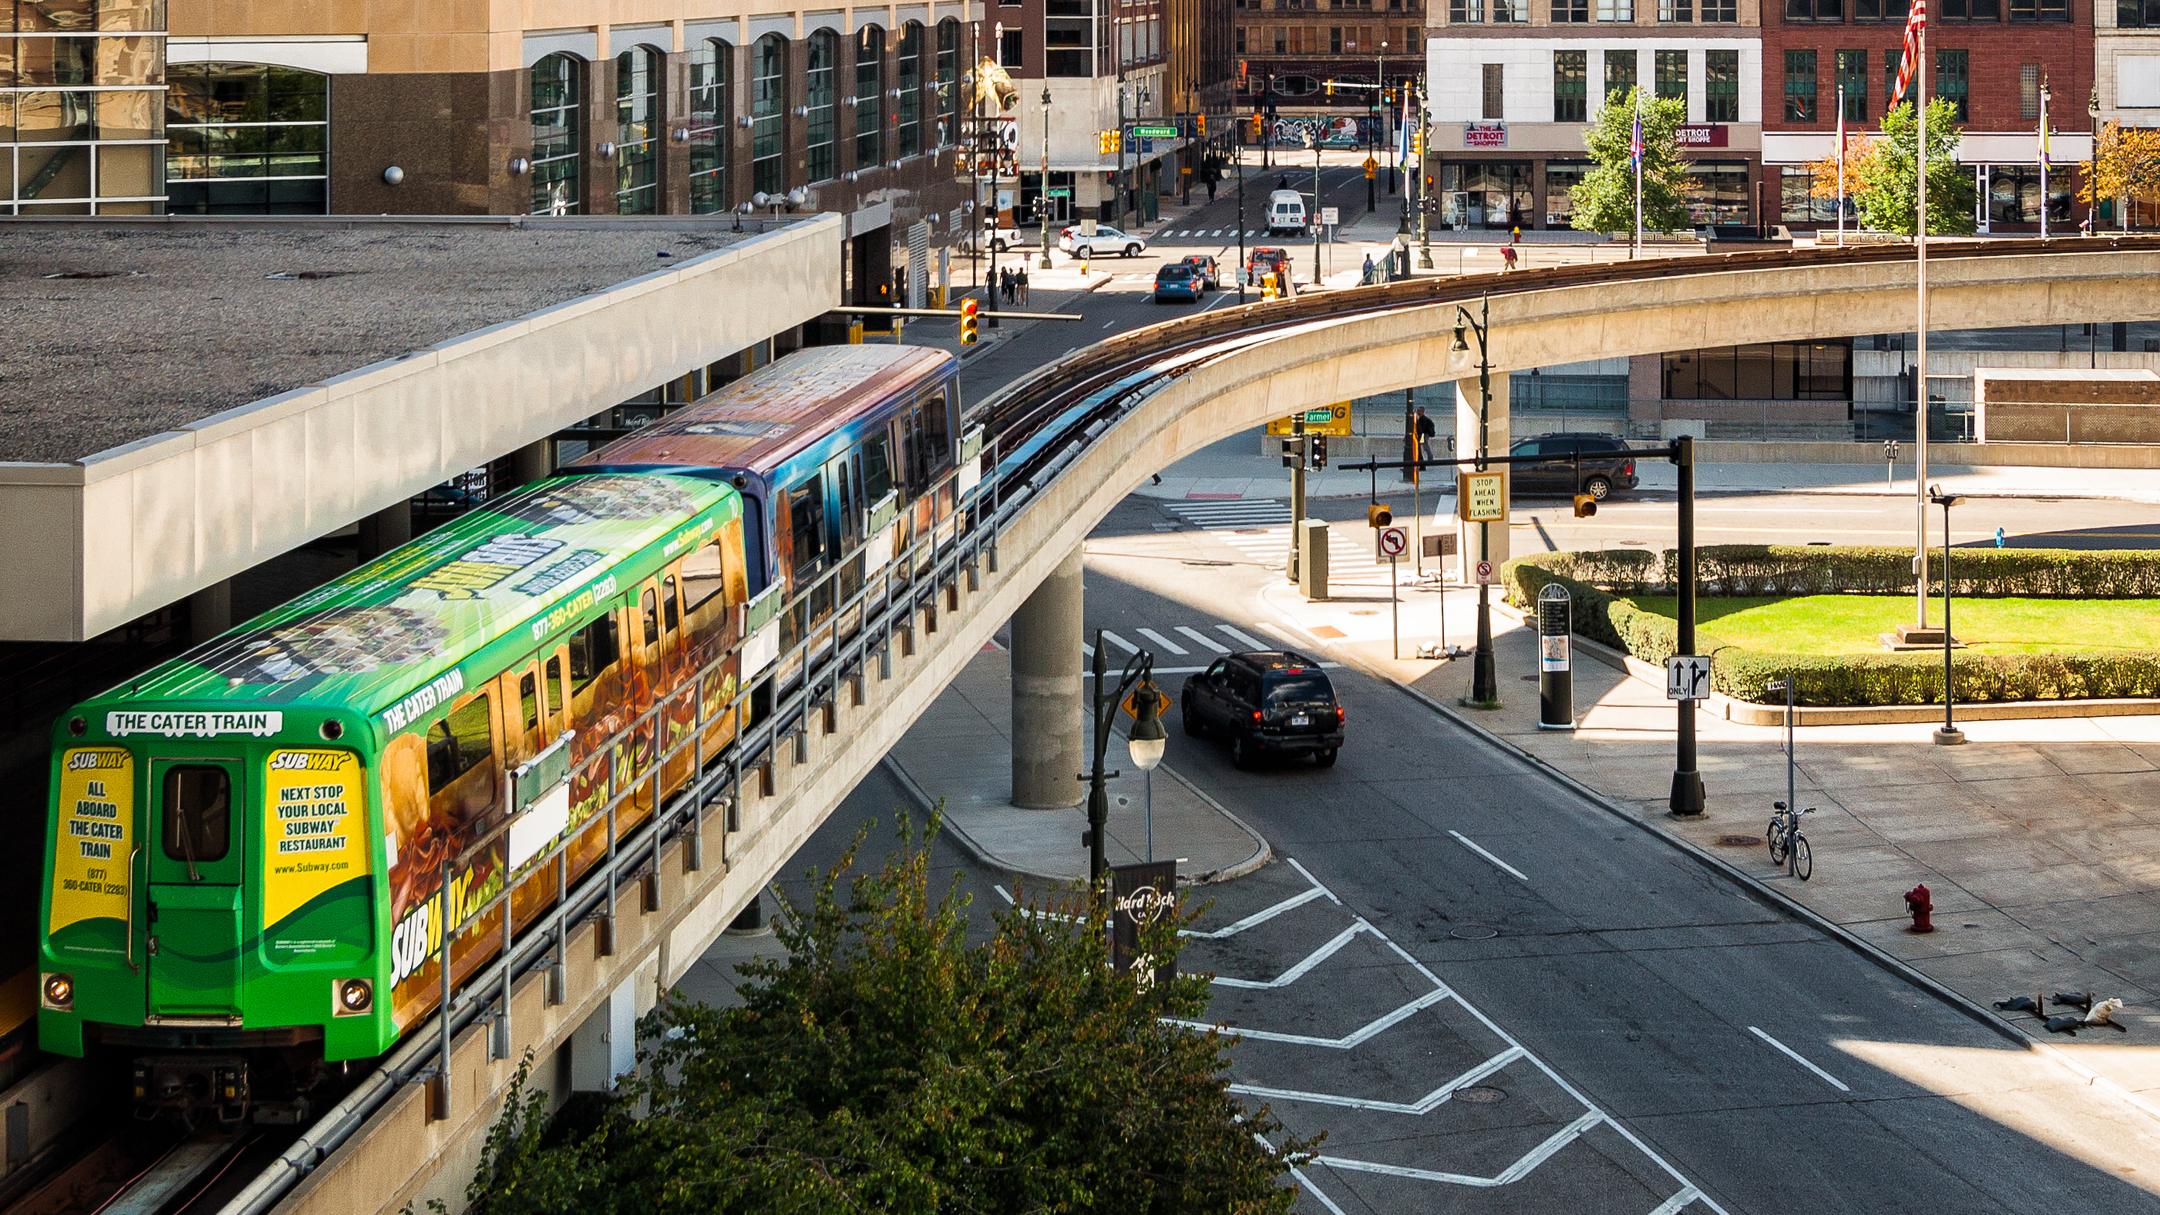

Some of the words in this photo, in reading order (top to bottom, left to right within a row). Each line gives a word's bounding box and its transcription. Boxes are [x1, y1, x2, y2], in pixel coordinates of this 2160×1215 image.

[1466, 132, 1505, 140] DETROIT
[1675, 128, 1711, 137] DETROIT
[1476, 478, 1494, 487] STOP
[1474, 488, 1496, 497] AHEAD
[1469, 507, 1502, 517] FLASHING
[1668, 687, 1688, 696] ONLY
[382, 702, 407, 735] THE
[403, 684, 437, 723] CATER
[432, 667, 464, 704] TRAIN
[115, 714, 147, 729] THE
[151, 714, 206, 729] CATER
[212, 714, 267, 729] TRAIN
[68, 751, 132, 772] SUBWAY
[269, 751, 351, 771] SUBWAY
[87, 781, 106, 797] ALL
[281, 787, 311, 801] NEXT
[314, 785, 344, 799] STOP
[76, 801, 117, 818] ABOARD
[278, 804, 309, 818] YOUR
[311, 802, 347, 816] LOCAL
[69, 820, 90, 836] THE
[91, 822, 123, 839] CATER
[80, 841, 111, 859] TRAIN
[279, 837, 346, 852] RESTAURANT
[87, 867, 107, 881] (877)
[274, 862, 349, 875] www.Subway.com
[63, 878, 102, 893] 360-CATER
[1115, 894, 1145, 912] Hard
